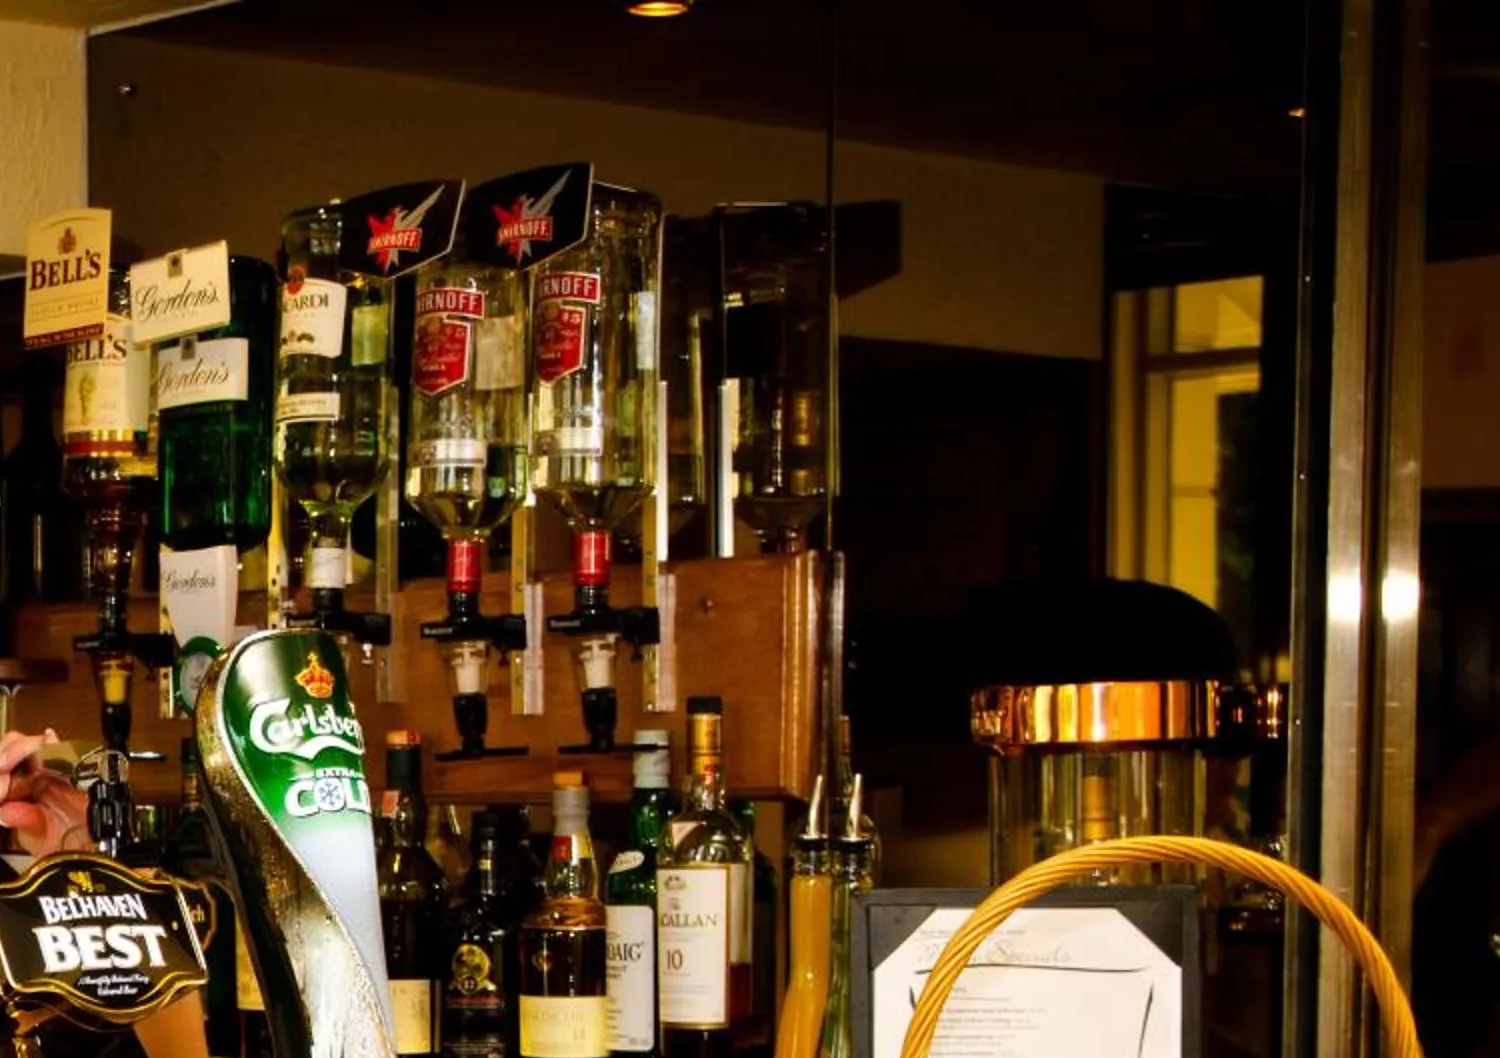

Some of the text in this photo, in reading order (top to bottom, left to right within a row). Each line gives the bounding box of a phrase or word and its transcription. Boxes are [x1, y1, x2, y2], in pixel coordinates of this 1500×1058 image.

[29, 249, 101, 292] BELL'S
[134, 280, 219, 321] Gordon's
[159, 359, 229, 392] Gordon's
[39, 893, 149, 925] BELHAVEN
[31, 924, 168, 973] BEST
[666, 948, 683, 970] 10
